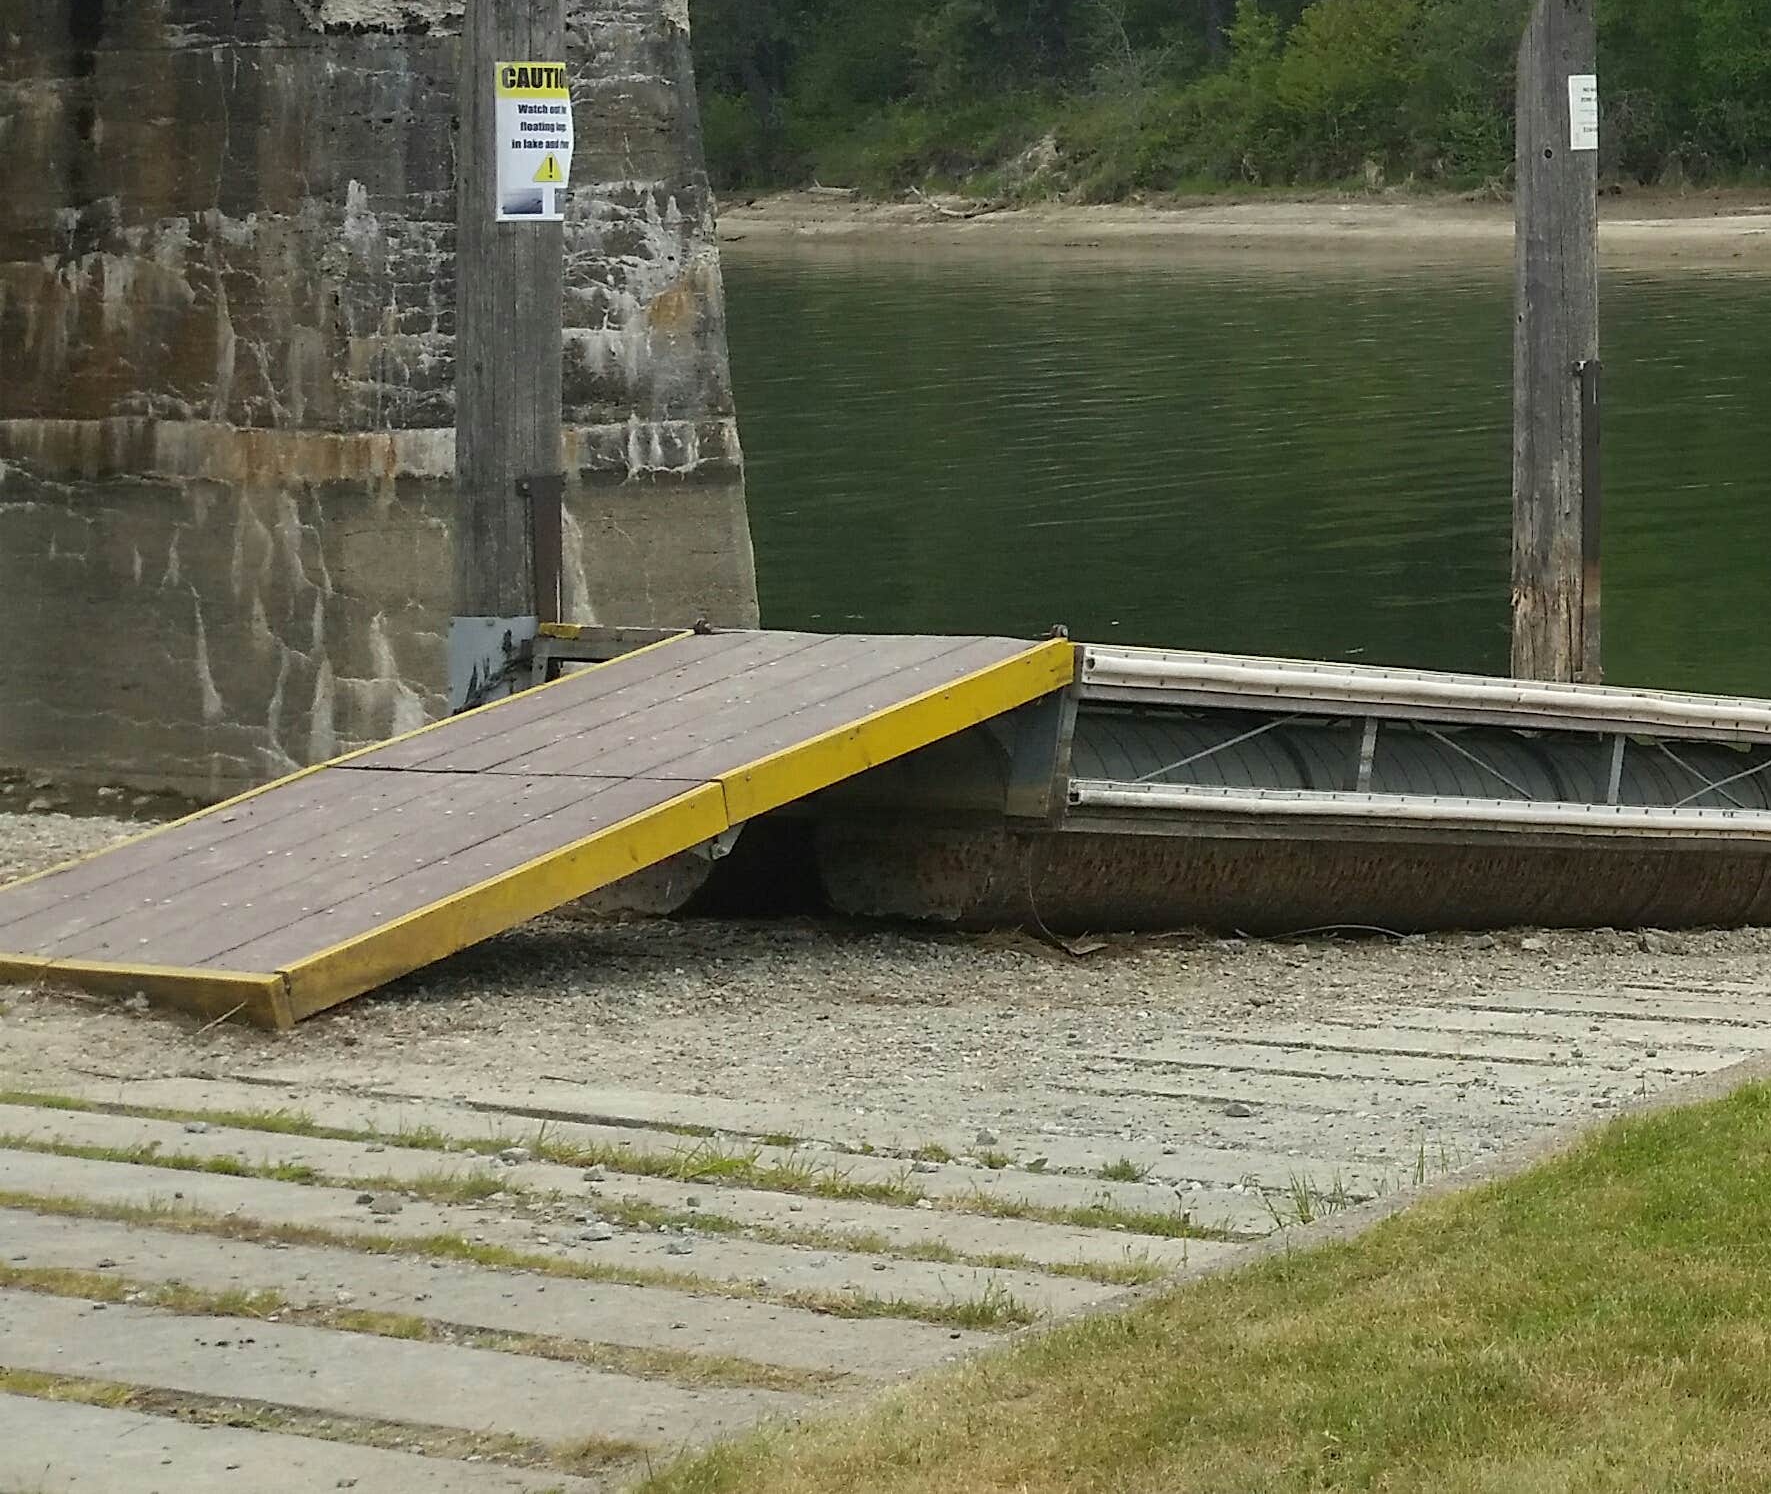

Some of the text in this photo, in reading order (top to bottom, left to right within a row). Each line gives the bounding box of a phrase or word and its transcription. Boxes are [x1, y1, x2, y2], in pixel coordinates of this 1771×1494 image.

[518, 104, 548, 114] Watch
[521, 122, 555, 132] floating
[512, 139, 543, 148] in lake
